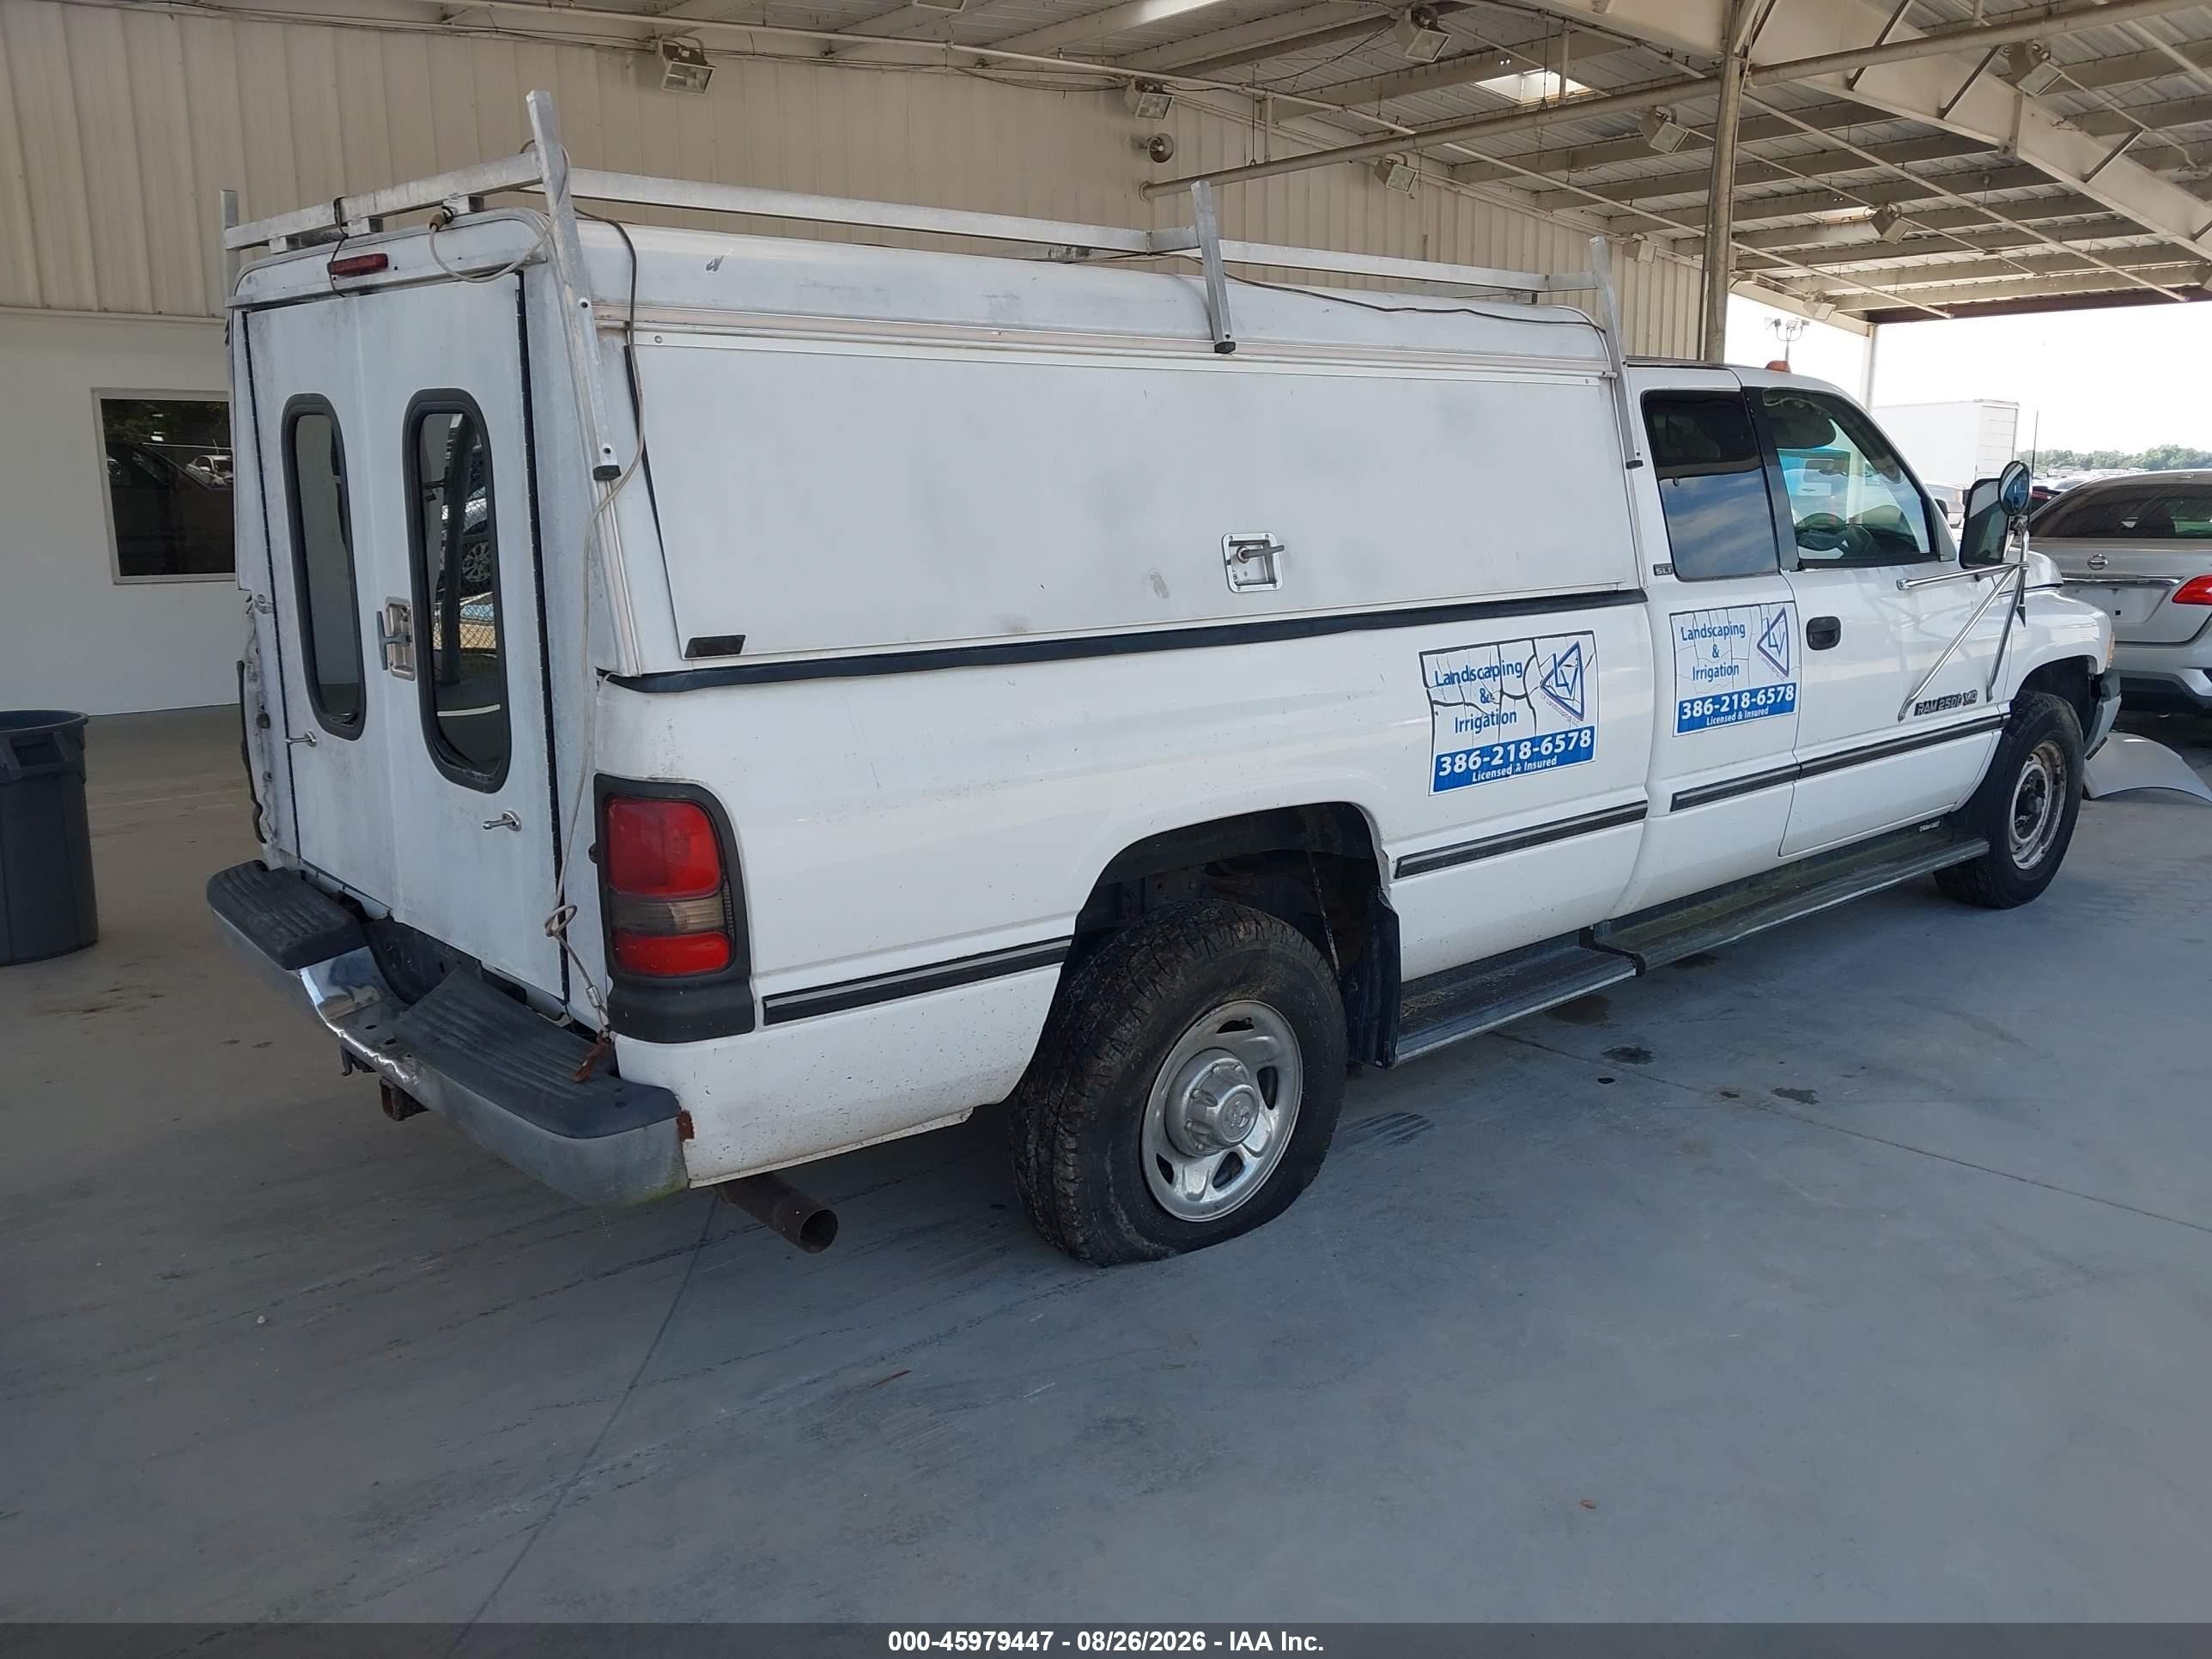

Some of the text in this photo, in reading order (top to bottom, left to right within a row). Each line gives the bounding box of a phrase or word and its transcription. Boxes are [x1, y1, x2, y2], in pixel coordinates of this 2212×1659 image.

[1680, 621, 1746, 641] Landscaping
[1712, 644, 1719, 658] &
[1434, 659, 1522, 686] Landscaping
[1692, 662, 1740, 682] Irrigation
[1480, 687, 1490, 703] &
[1681, 685, 1795, 720] 386-218-6578
[1706, 707, 1769, 726] Licensed & Insured
[1916, 699, 1938, 716] RAM
[1454, 708, 1517, 734] Irrigation
[1438, 730, 1592, 776] 386-218-6578
[1472, 756, 1557, 782] Licensed & Insured
